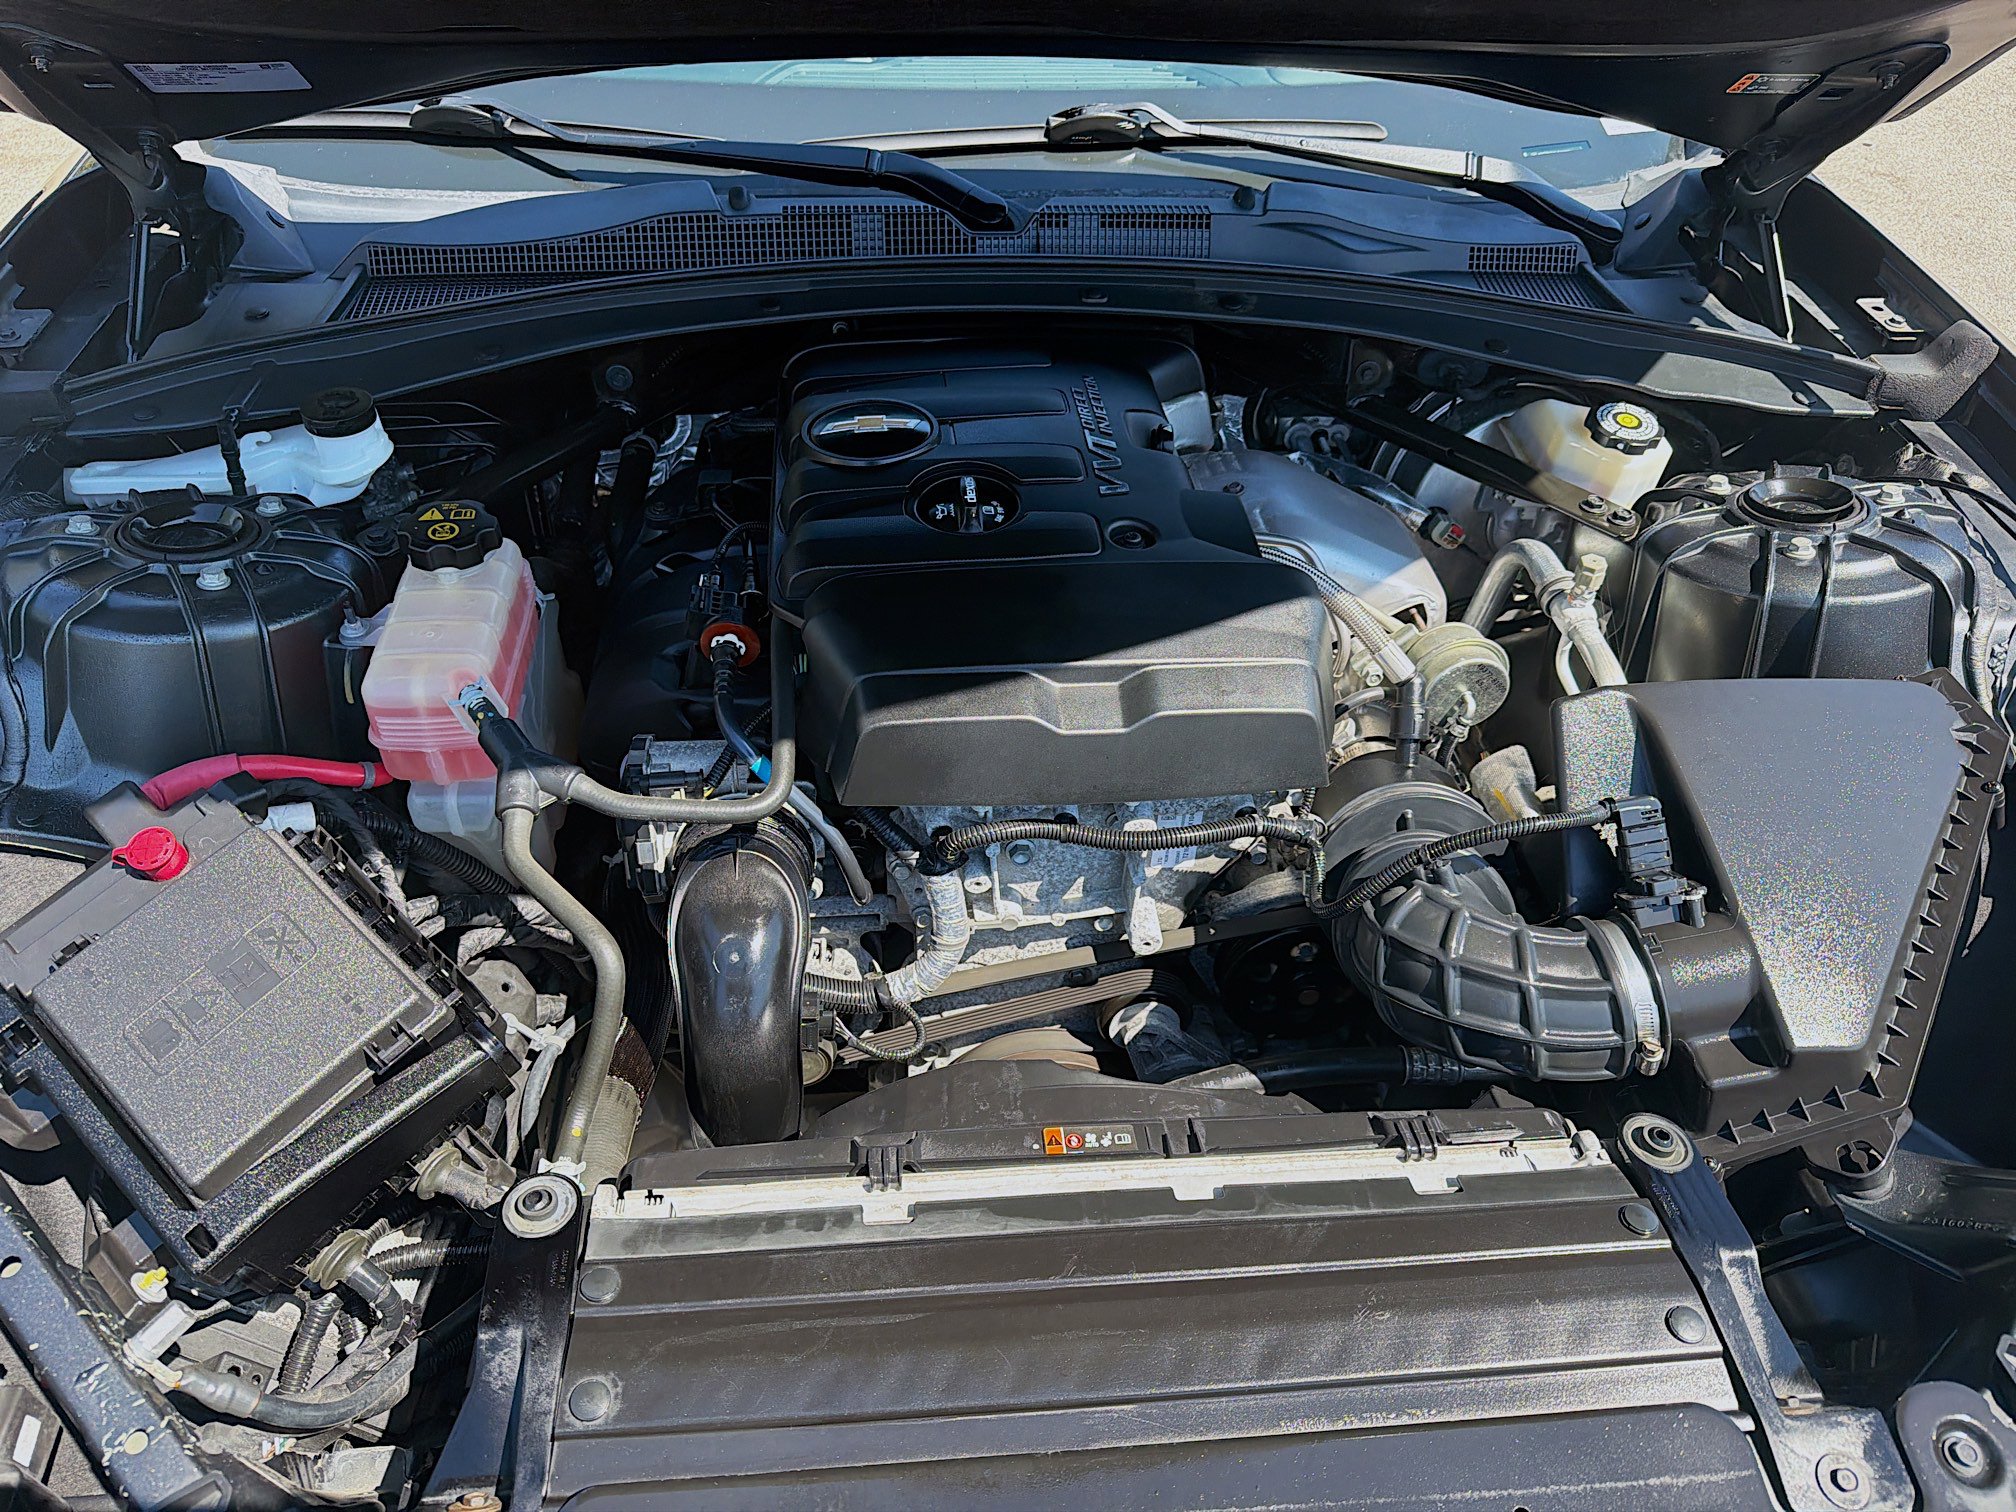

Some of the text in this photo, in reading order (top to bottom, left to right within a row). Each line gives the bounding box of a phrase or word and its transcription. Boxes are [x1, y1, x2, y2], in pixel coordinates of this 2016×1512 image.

[1070, 386, 1095, 431] DIRECT
[1082, 376, 1113, 437] INJECTION
[1083, 429, 1130, 496] VVT
[964, 476, 977, 503] dexos
